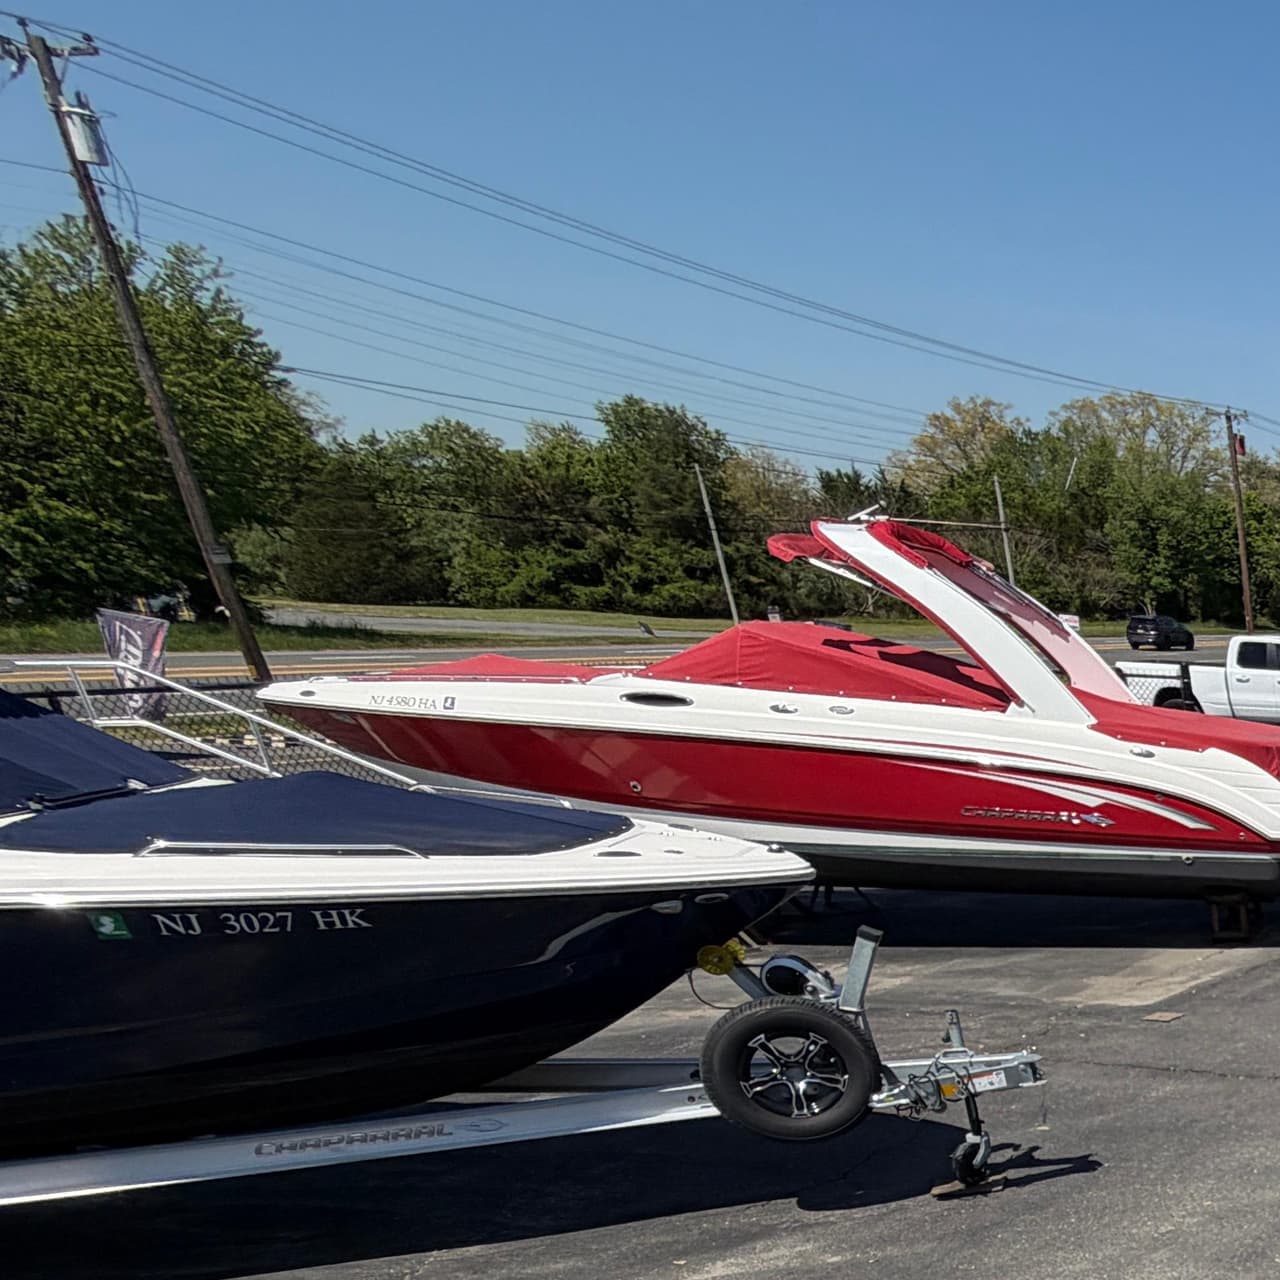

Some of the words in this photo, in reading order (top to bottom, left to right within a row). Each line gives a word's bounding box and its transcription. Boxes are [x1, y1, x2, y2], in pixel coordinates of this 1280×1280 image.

[369, 695, 385, 705] NJ
[152, 913, 202, 936] NJ
[219, 911, 293, 935] 3027
[311, 908, 374, 931] HK
[253, 1123, 454, 1156] CHAPARRAL
